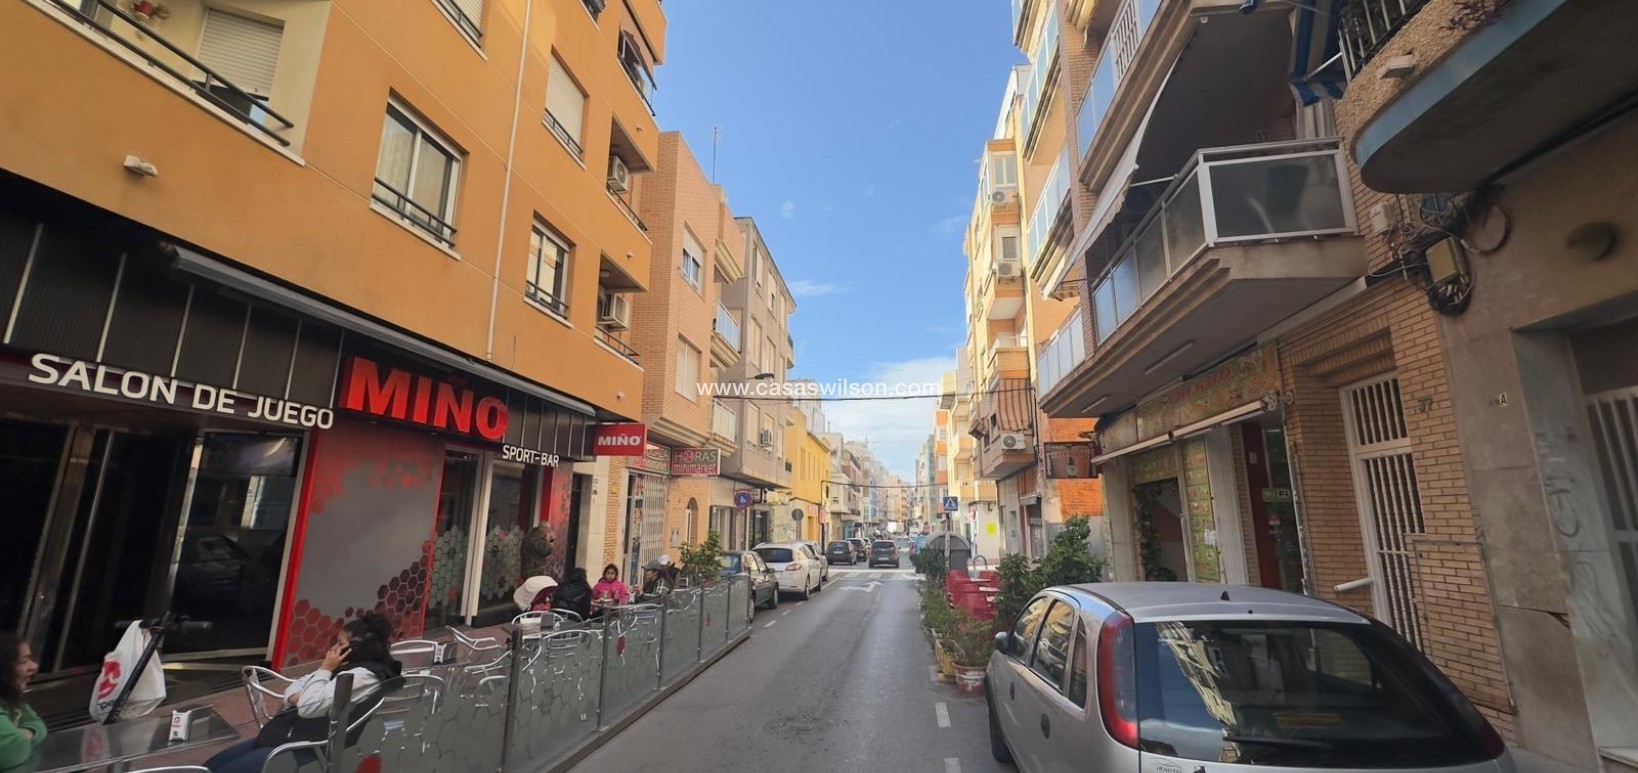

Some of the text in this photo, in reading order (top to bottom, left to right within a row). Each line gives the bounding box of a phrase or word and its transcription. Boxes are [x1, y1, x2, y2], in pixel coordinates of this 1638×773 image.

[28, 353, 334, 430] SALON DE JUEGO
[598, 433, 641, 446] MIÑO
[502, 444, 559, 468] SPORT-BAR
